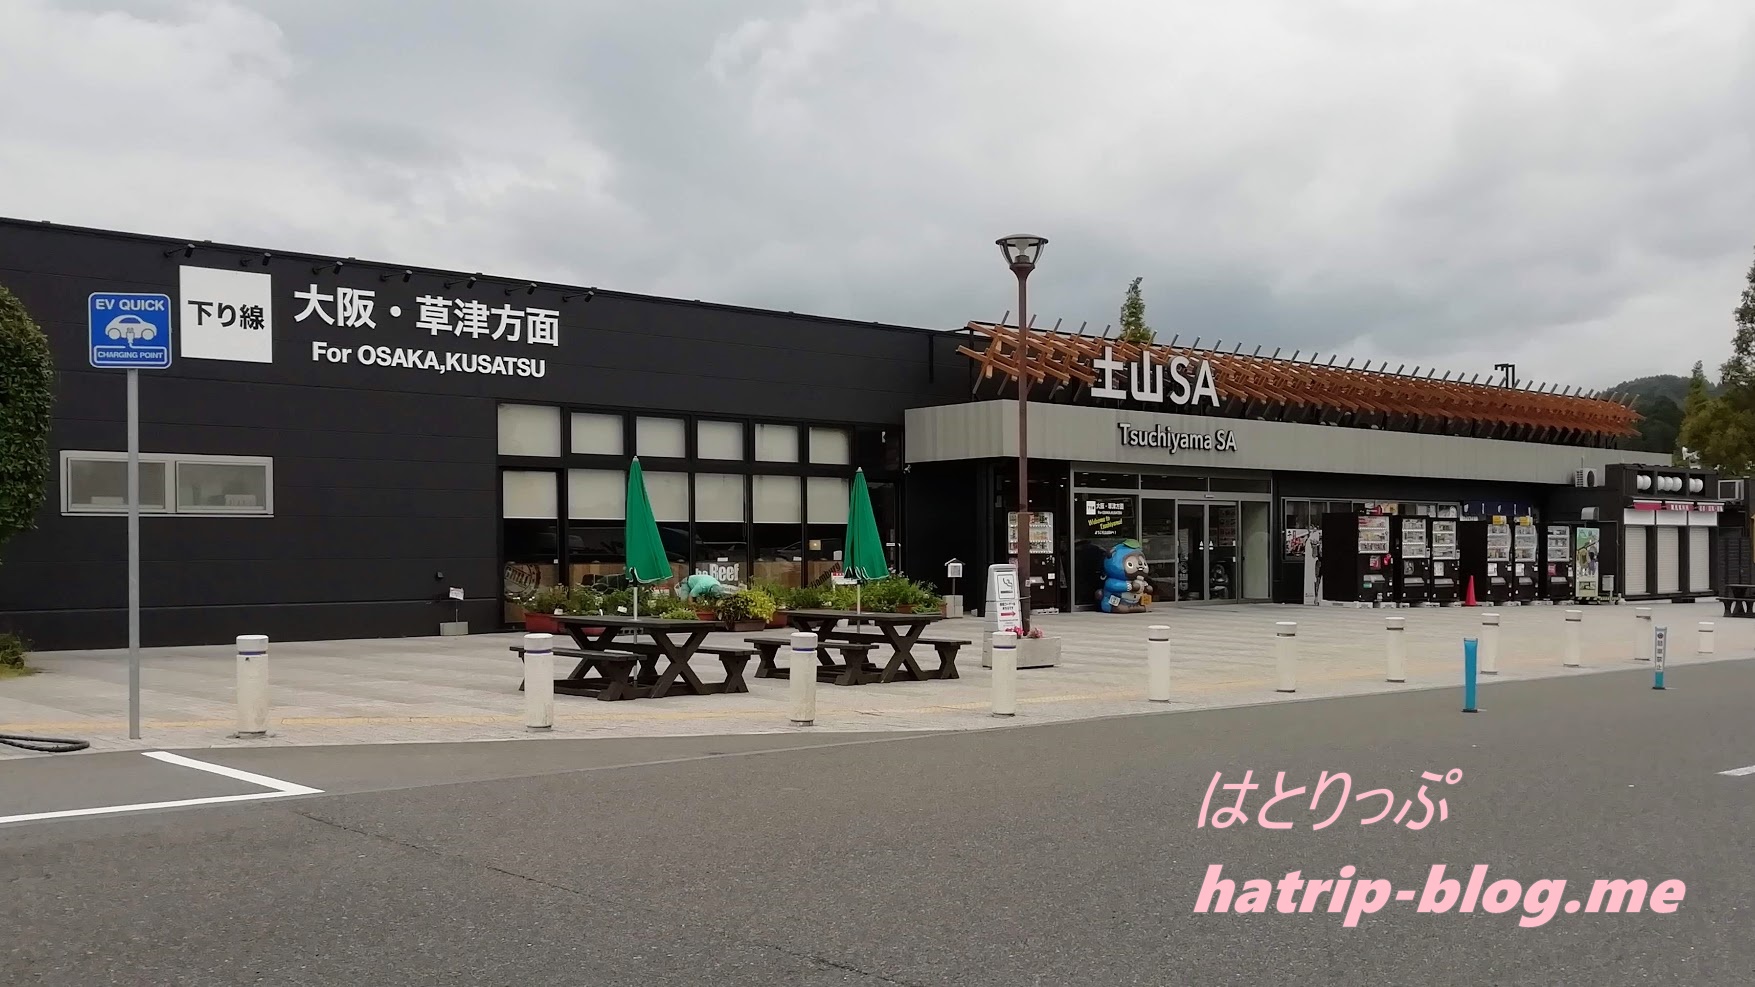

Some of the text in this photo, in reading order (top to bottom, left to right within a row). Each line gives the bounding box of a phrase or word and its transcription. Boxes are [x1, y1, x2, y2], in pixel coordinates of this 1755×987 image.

[95, 298, 165, 311] EV QUICK
[187, 299, 265, 331] 下り線
[294, 284, 559, 346] 大阪・草津方面
[98, 351, 138, 359] CHARGING
[312, 341, 546, 378] For OSAKA,KUSATSU
[1090, 346, 1220, 407] 土山SA
[1118, 423, 1237, 454] Tsuchiyama SA
[709, 563, 739, 581] Beef
